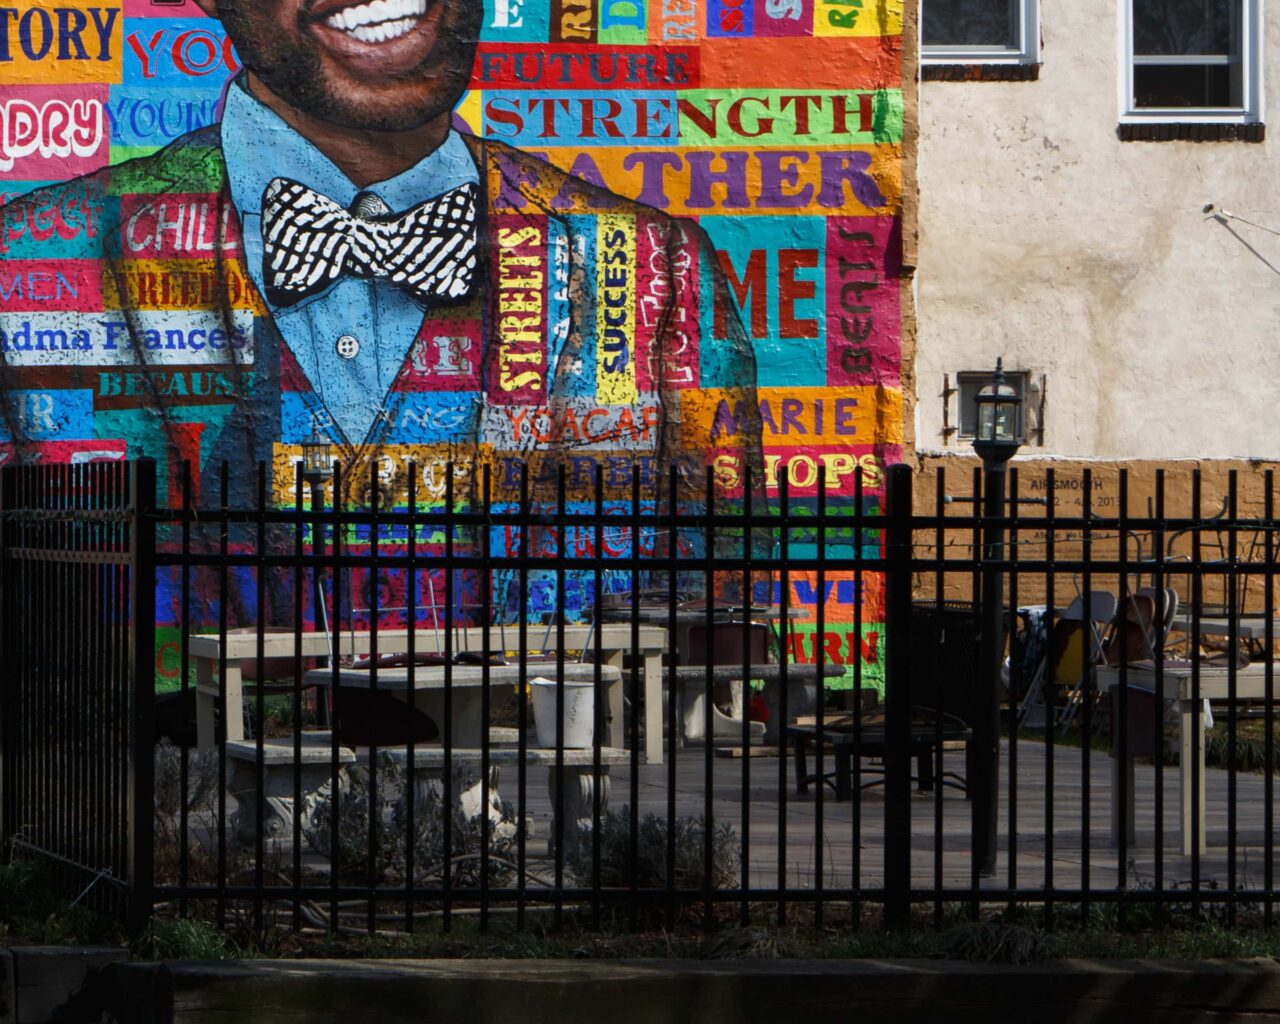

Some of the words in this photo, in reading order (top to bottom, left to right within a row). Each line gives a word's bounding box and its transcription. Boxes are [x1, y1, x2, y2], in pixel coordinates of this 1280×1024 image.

[478, 51, 689, 84] FUTURE
[104, 97, 221, 139] YOUN
[483, 93, 876, 140] STRENGTH
[491, 150, 889, 210] FATHER
[125, 202, 238, 253] CHILL
[497, 226, 544, 392] STREETS
[603, 228, 629, 374] SUCCESS
[713, 247, 820, 341] ME
[837, 224, 880, 375] BEATS
[709, 397, 859, 439] MARIE
